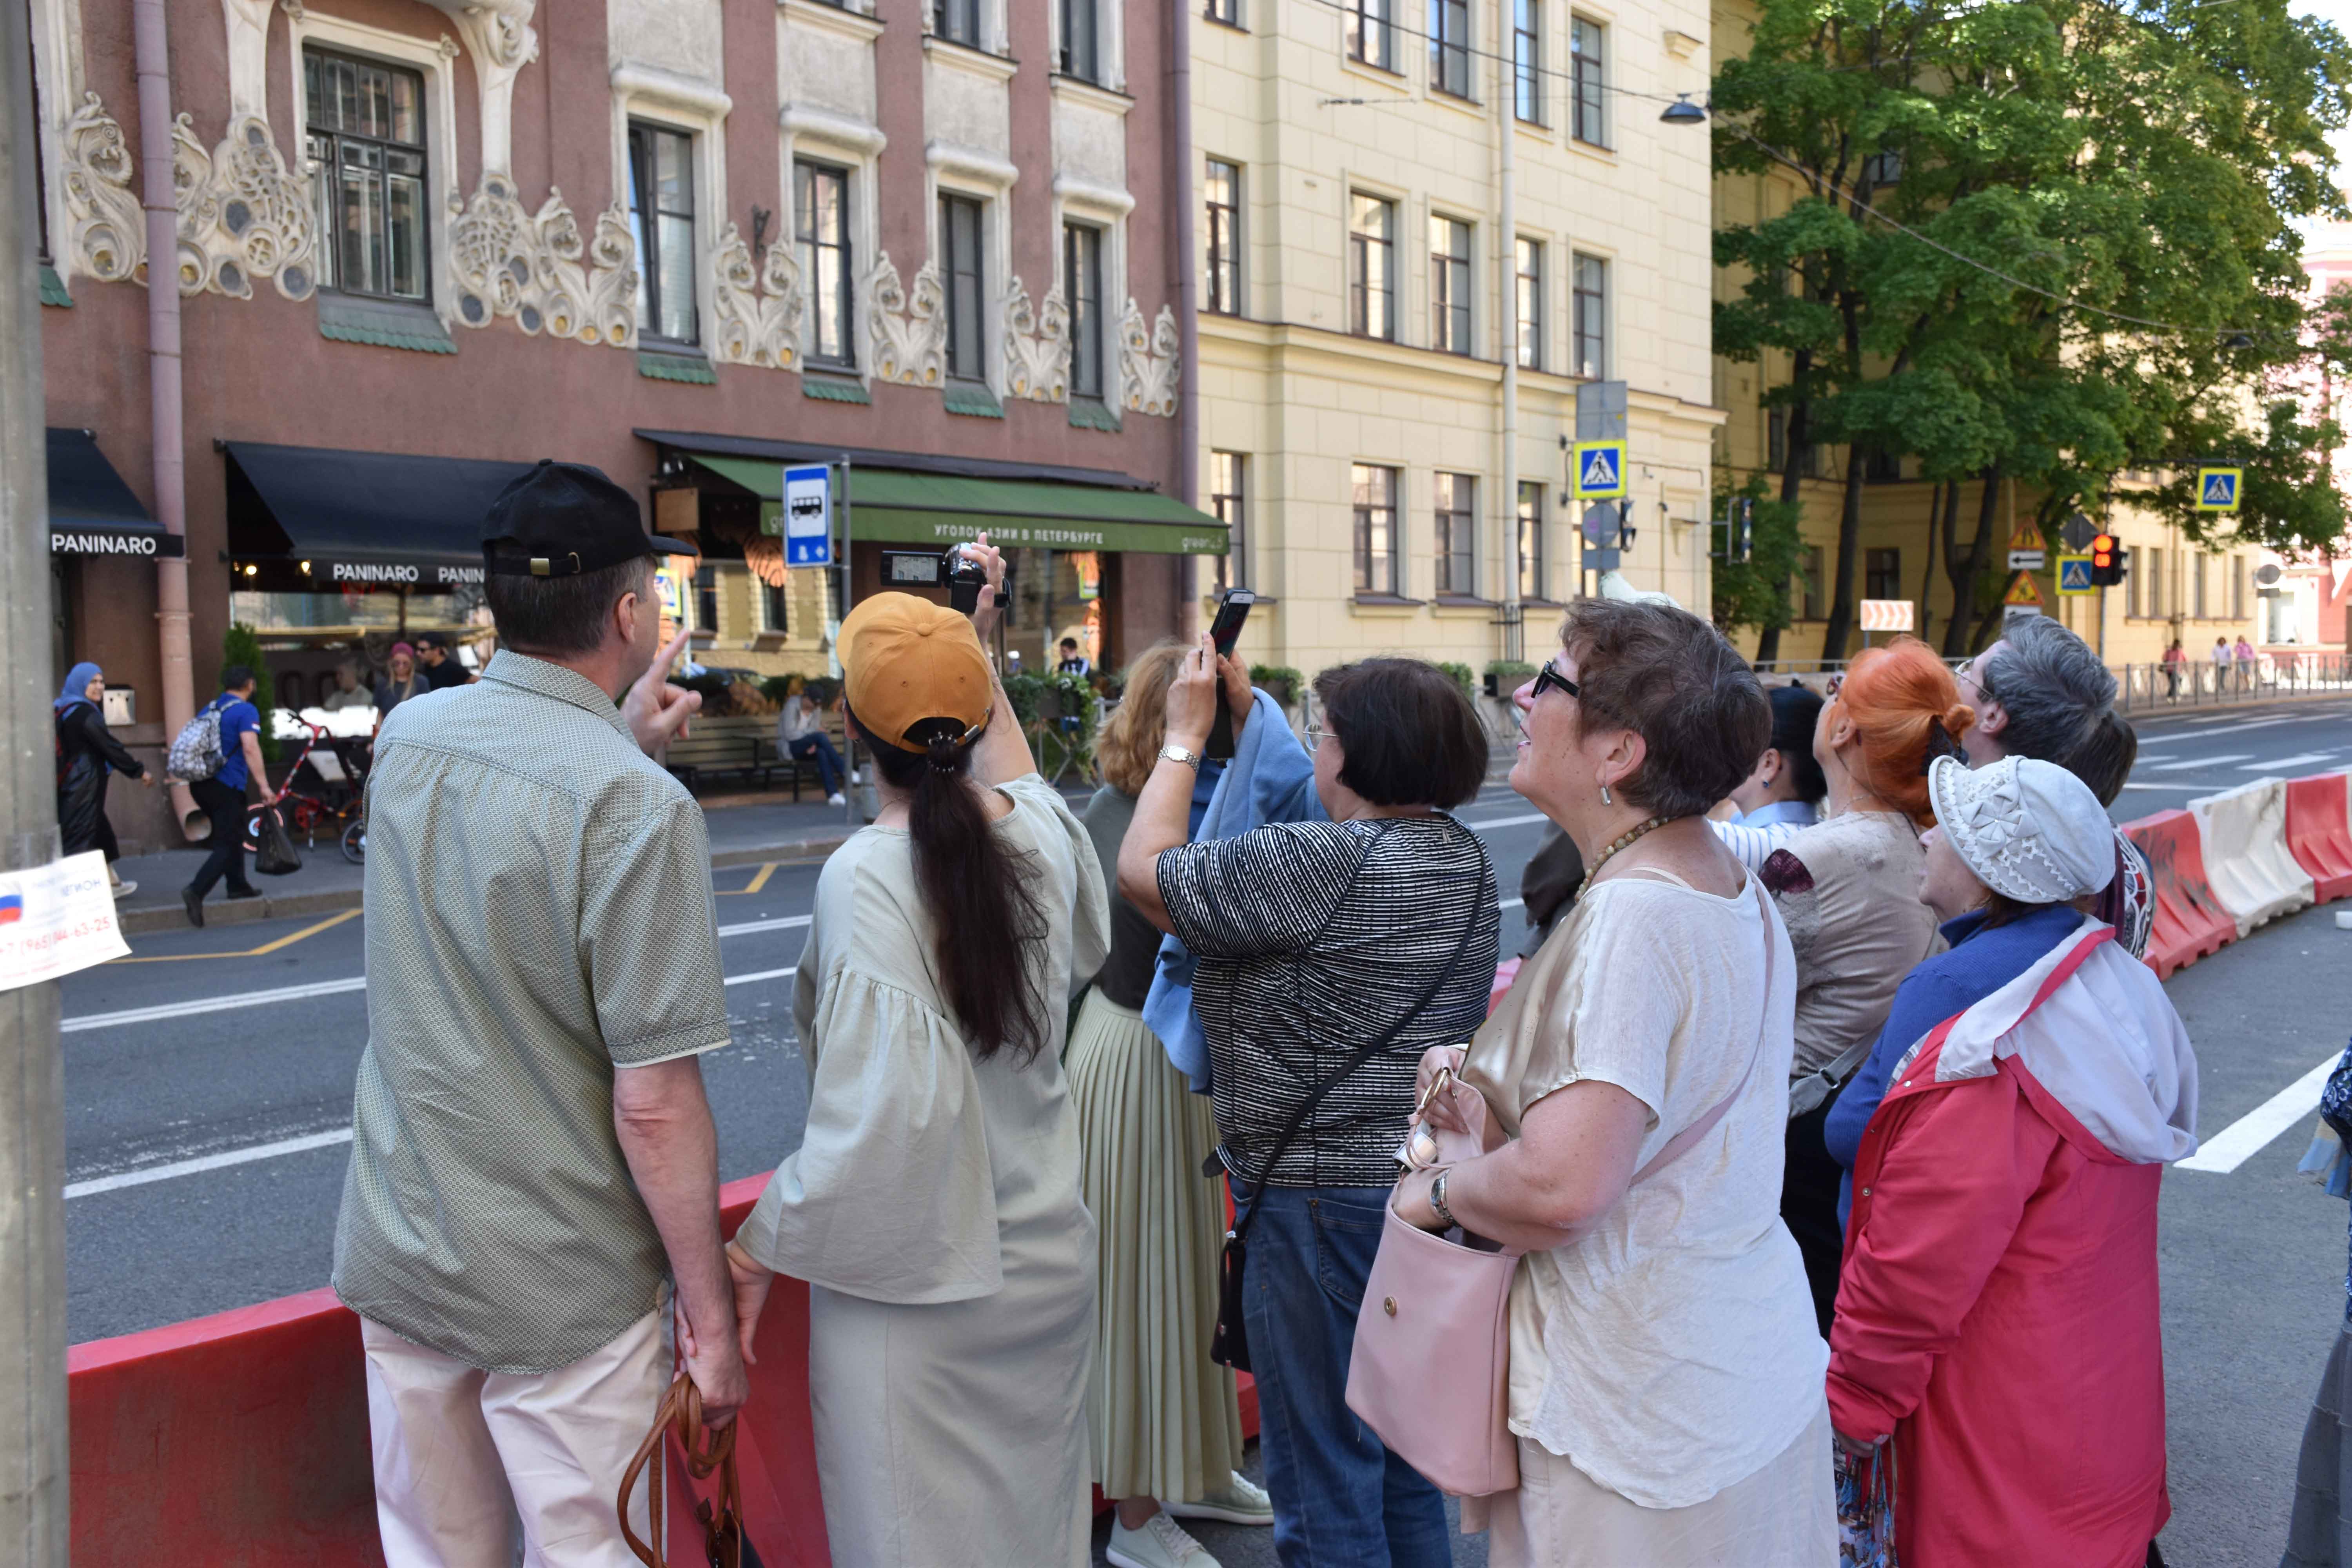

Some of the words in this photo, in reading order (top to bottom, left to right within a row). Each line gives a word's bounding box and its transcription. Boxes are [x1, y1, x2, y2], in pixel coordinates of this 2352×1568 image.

[934, 524, 982, 538] УГОЛОК
[986, 528, 1018, 540] АЗИИ
[1021, 529, 1029, 541] В
[1034, 530, 1103, 544] ПЕТЕРБУРГЕ
[52, 534, 156, 555] PANINARO
[333, 563, 419, 582] PANINARO
[438, 566, 484, 583] PANIN
